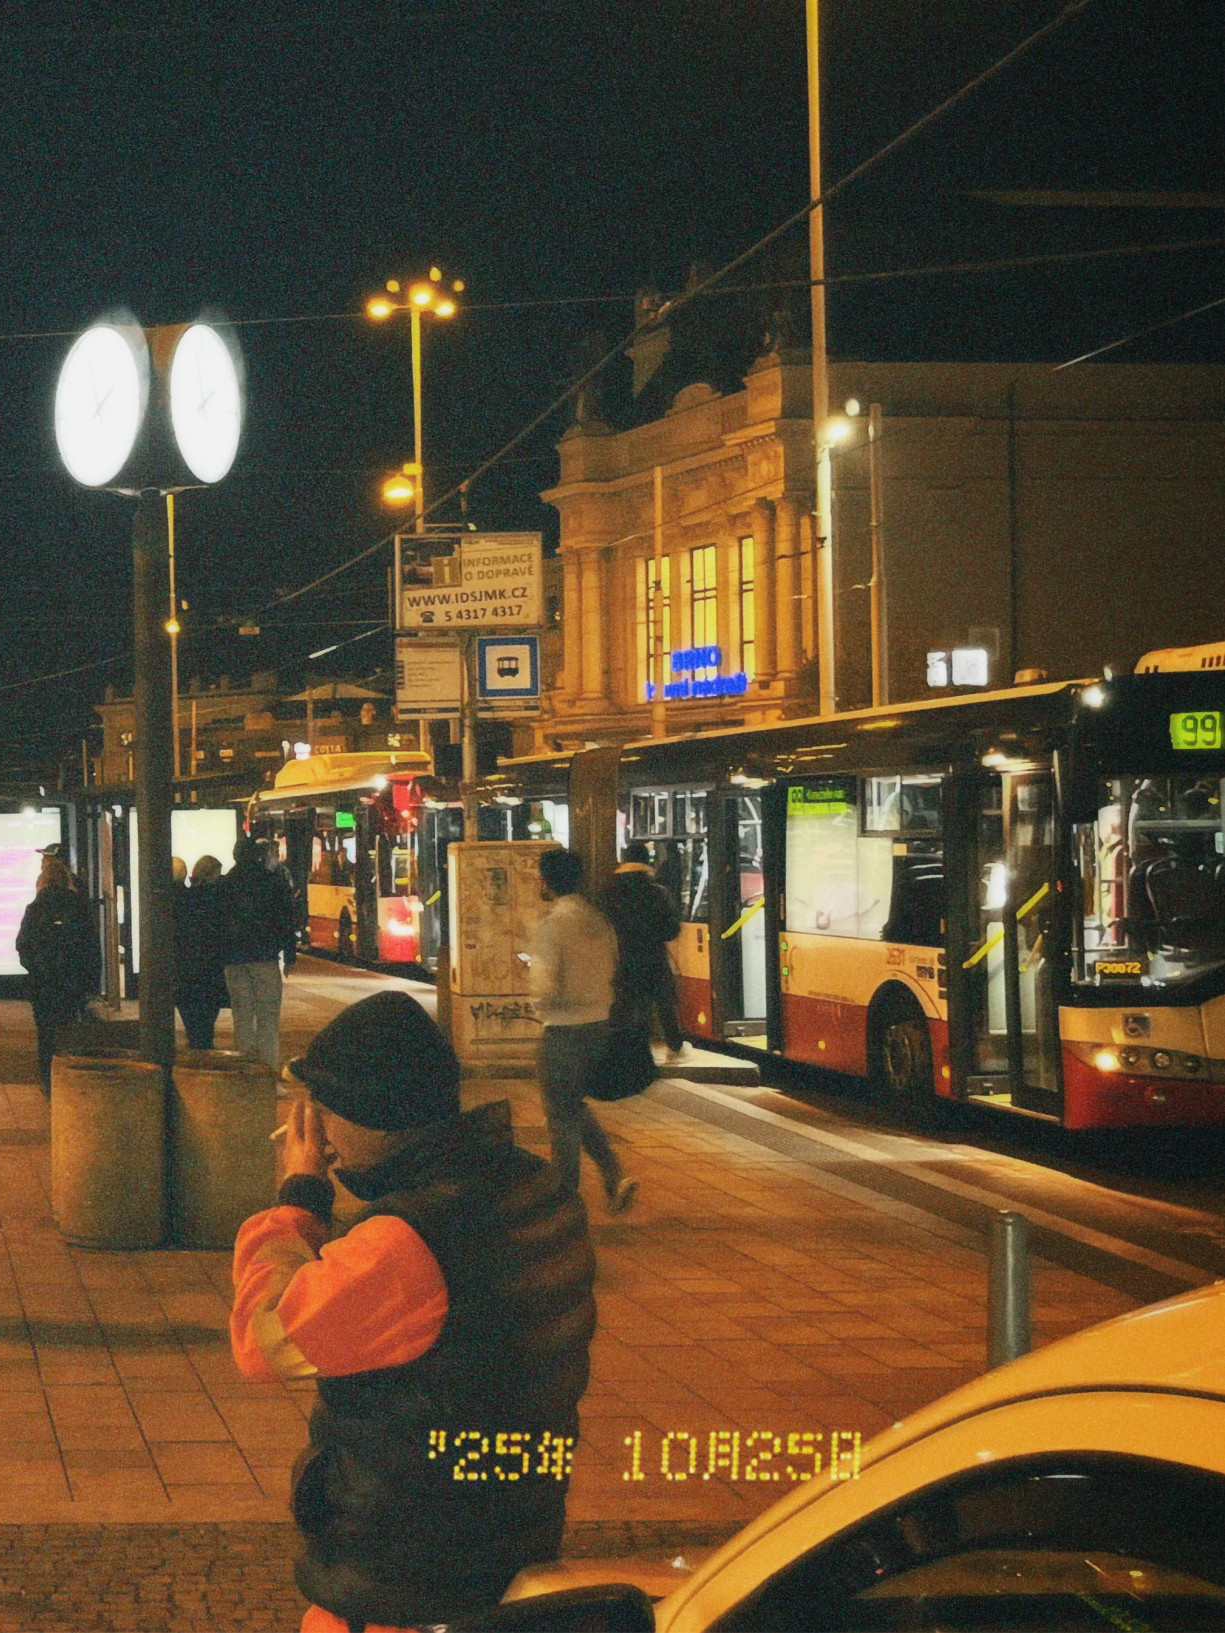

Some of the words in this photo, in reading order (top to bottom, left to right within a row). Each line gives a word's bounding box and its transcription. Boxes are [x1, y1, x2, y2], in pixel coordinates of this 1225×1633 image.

[462, 552, 534, 568] INFORMACE
[464, 571, 474, 582] O
[444, 610, 452, 622] 5
[456, 607, 487, 621] 4317
[491, 604, 523, 618] 4317
[1181, 714, 1217, 747] 99
